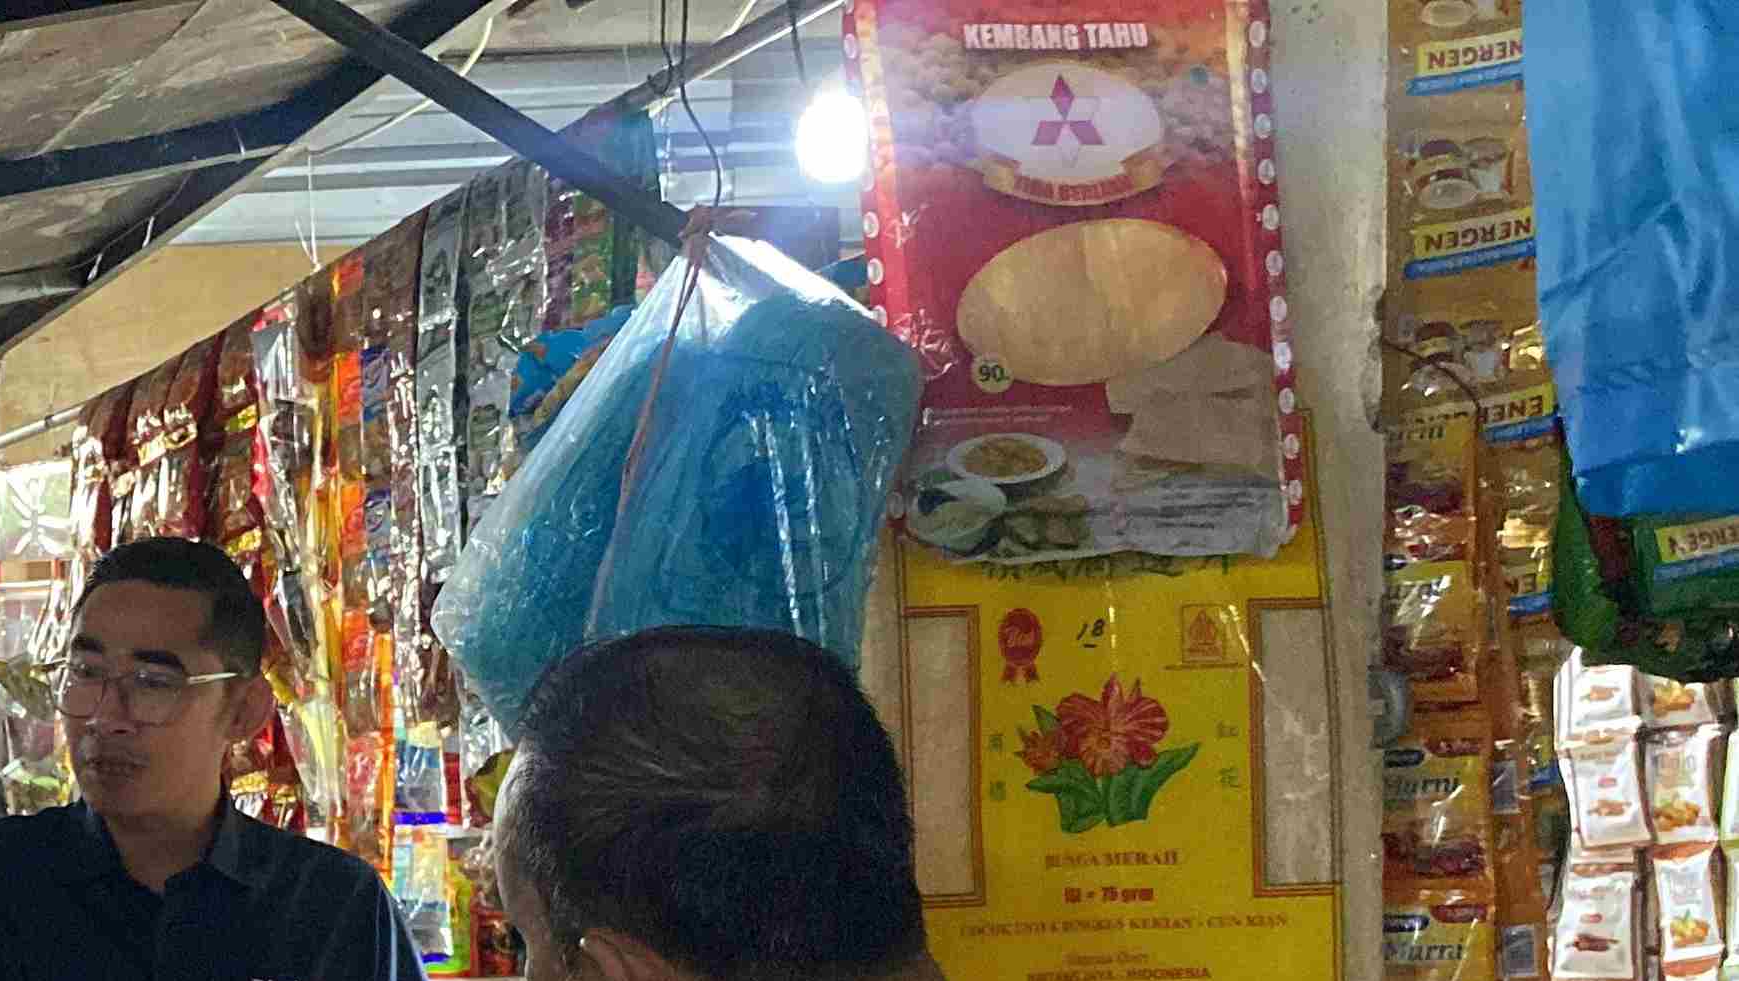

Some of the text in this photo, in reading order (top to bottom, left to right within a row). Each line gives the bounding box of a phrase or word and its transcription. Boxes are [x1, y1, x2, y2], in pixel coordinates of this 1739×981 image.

[964, 22, 1148, 50] KEMBANG TAHU
[1429, 39, 1522, 69] NERGEN
[1424, 215, 1531, 252] NERGEN
